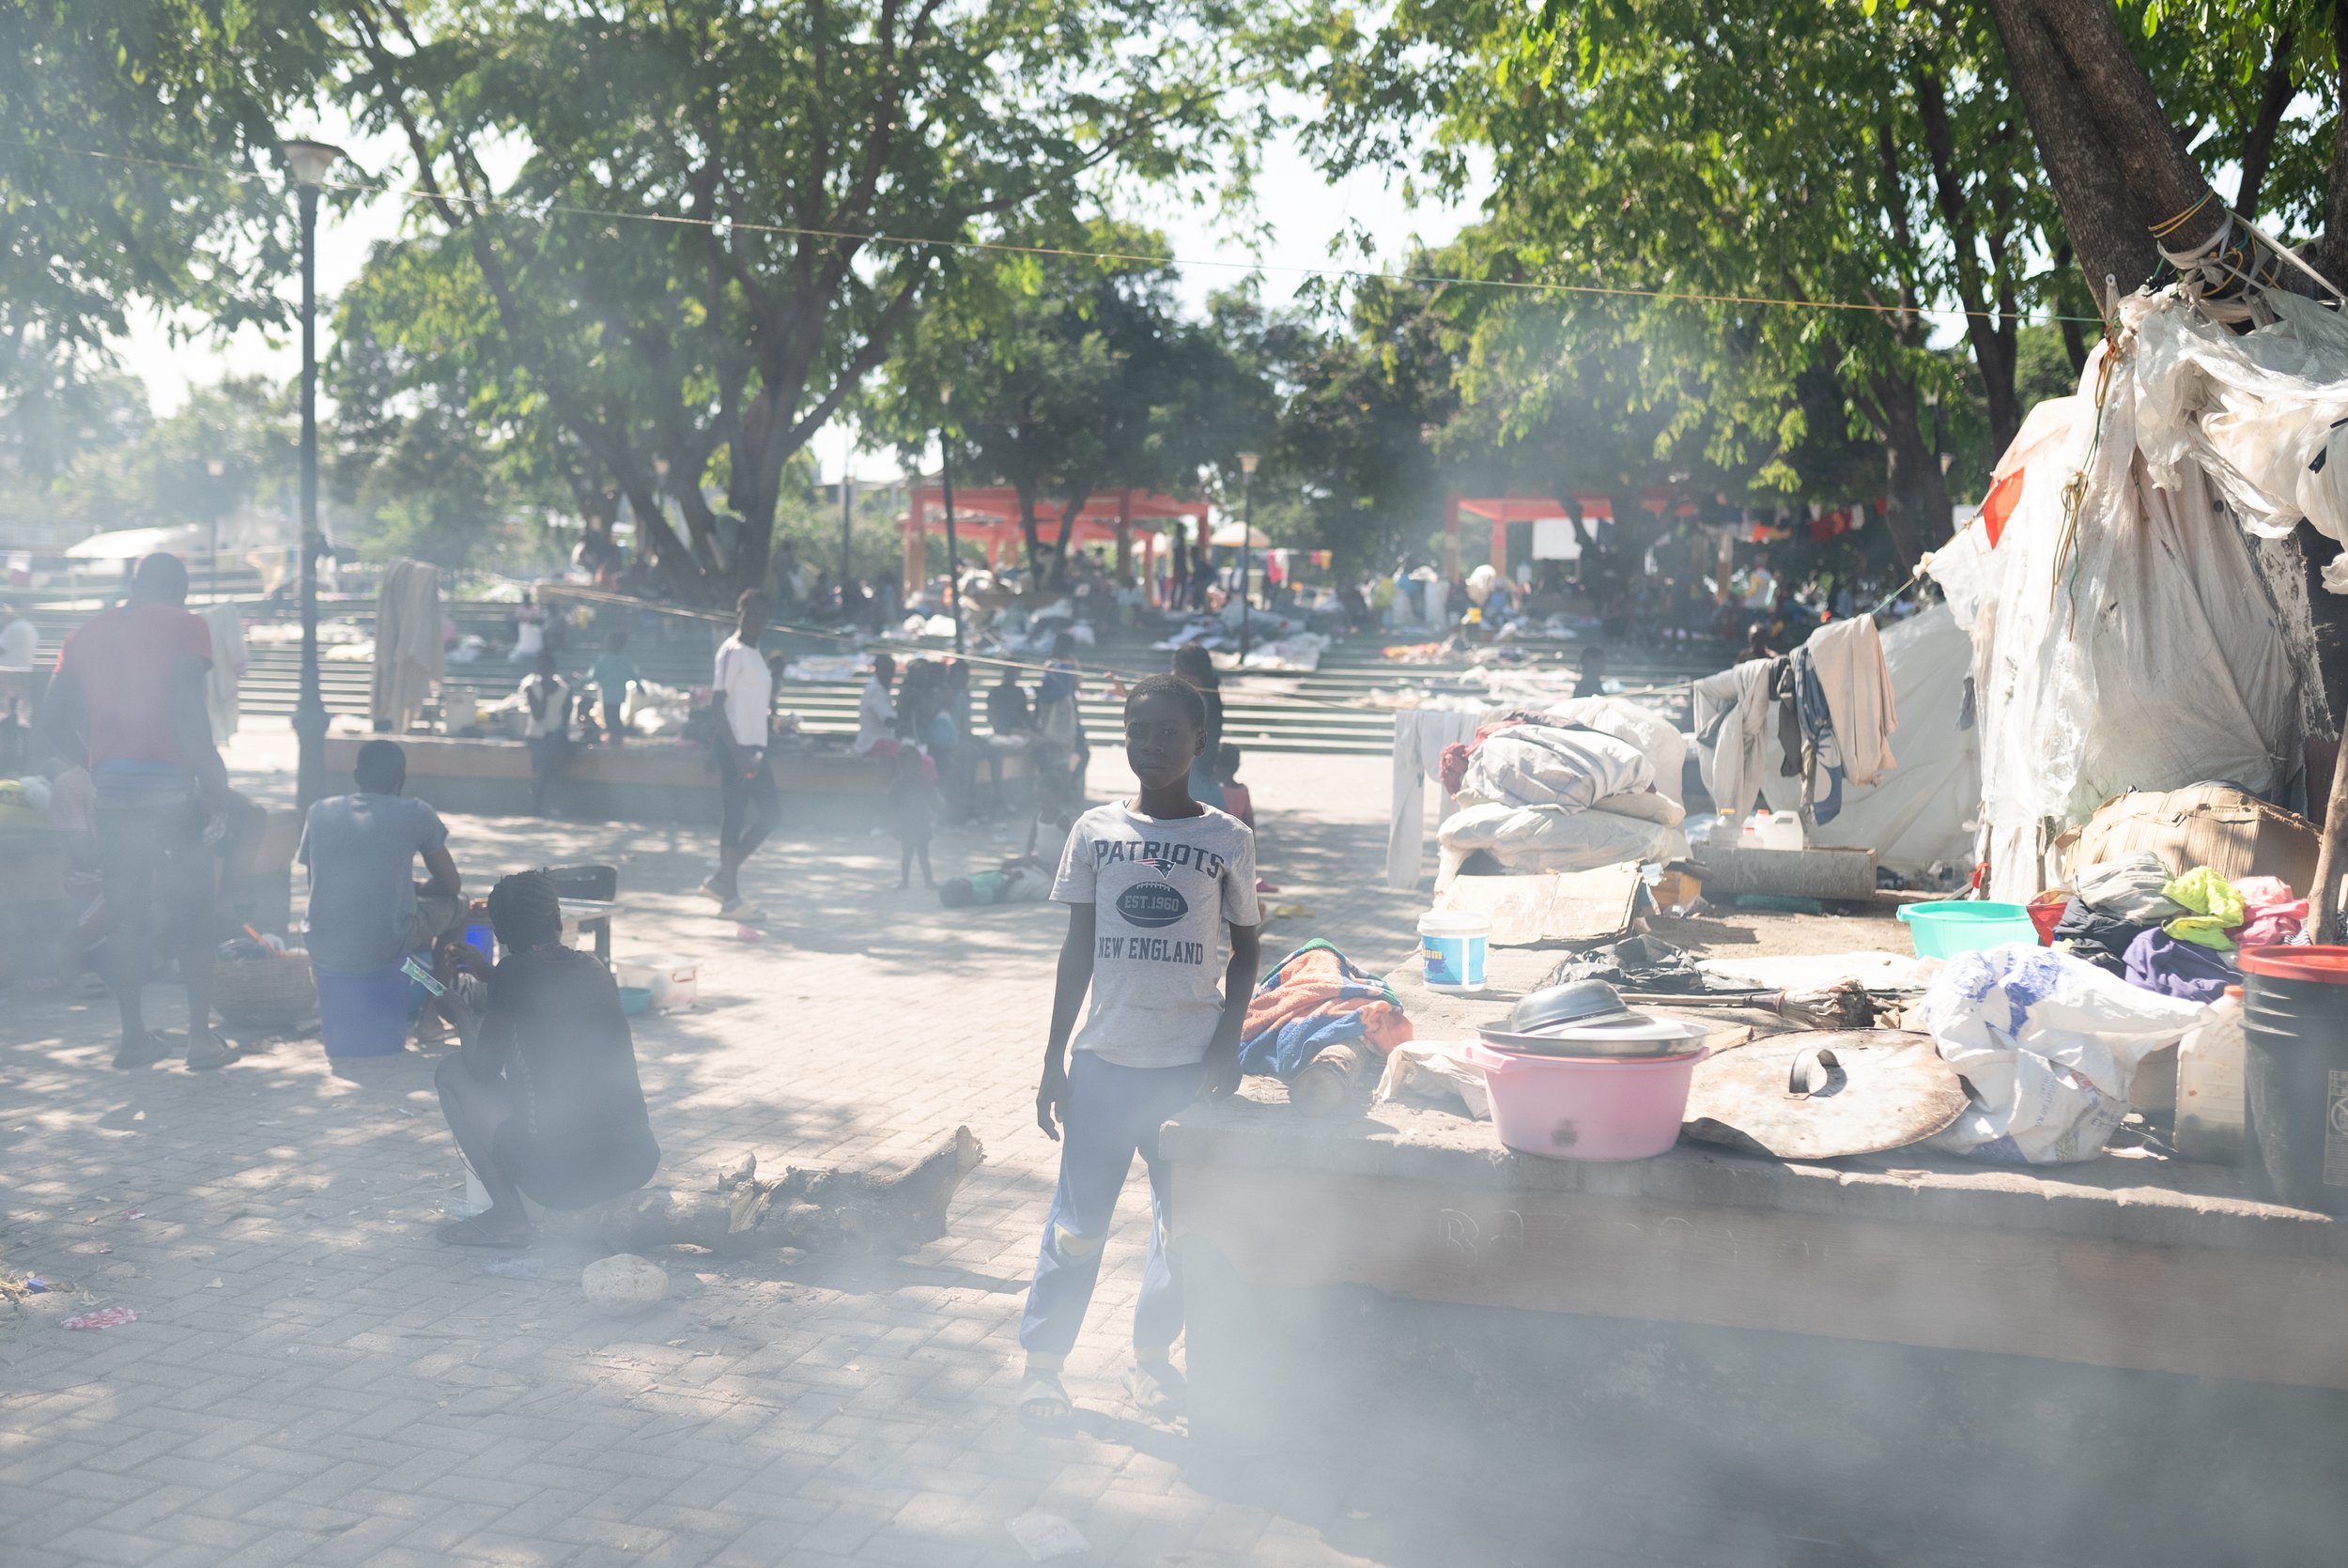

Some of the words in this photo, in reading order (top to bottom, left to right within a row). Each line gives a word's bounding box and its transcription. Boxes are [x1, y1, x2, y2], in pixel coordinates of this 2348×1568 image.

[1093, 839, 1225, 879] PATRIOTS
[1098, 936, 1125, 959] NEW
[1128, 937, 1204, 965] ENGLAND
